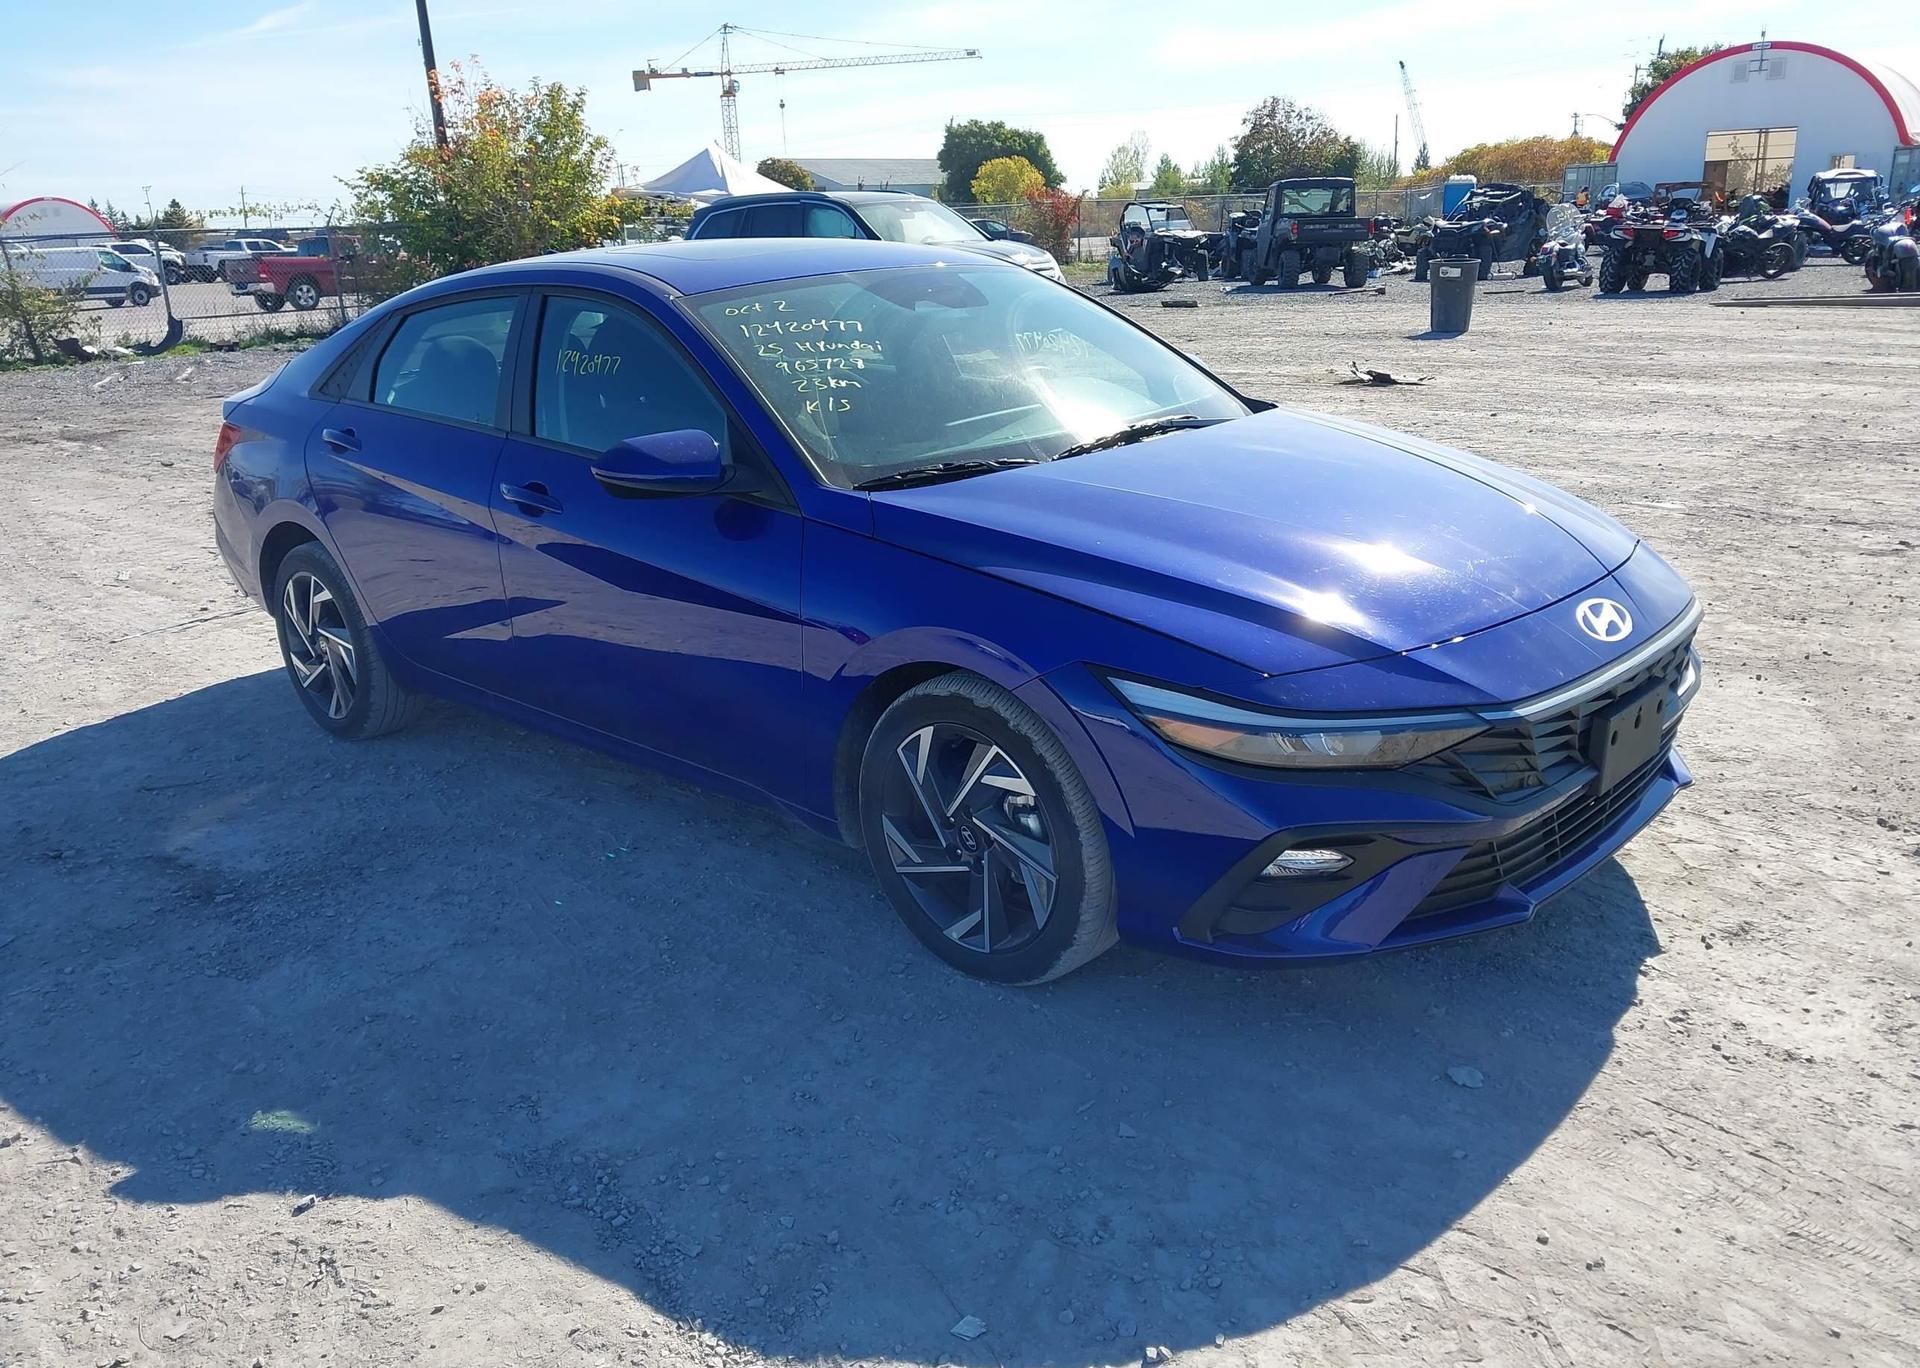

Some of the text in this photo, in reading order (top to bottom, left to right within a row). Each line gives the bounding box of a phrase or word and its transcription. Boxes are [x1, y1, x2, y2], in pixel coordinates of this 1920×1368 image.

[773, 300, 796, 312] 2
[740, 318, 863, 338] 12420477
[555, 349, 621, 376] 12420477
[775, 357, 865, 375] 965728
